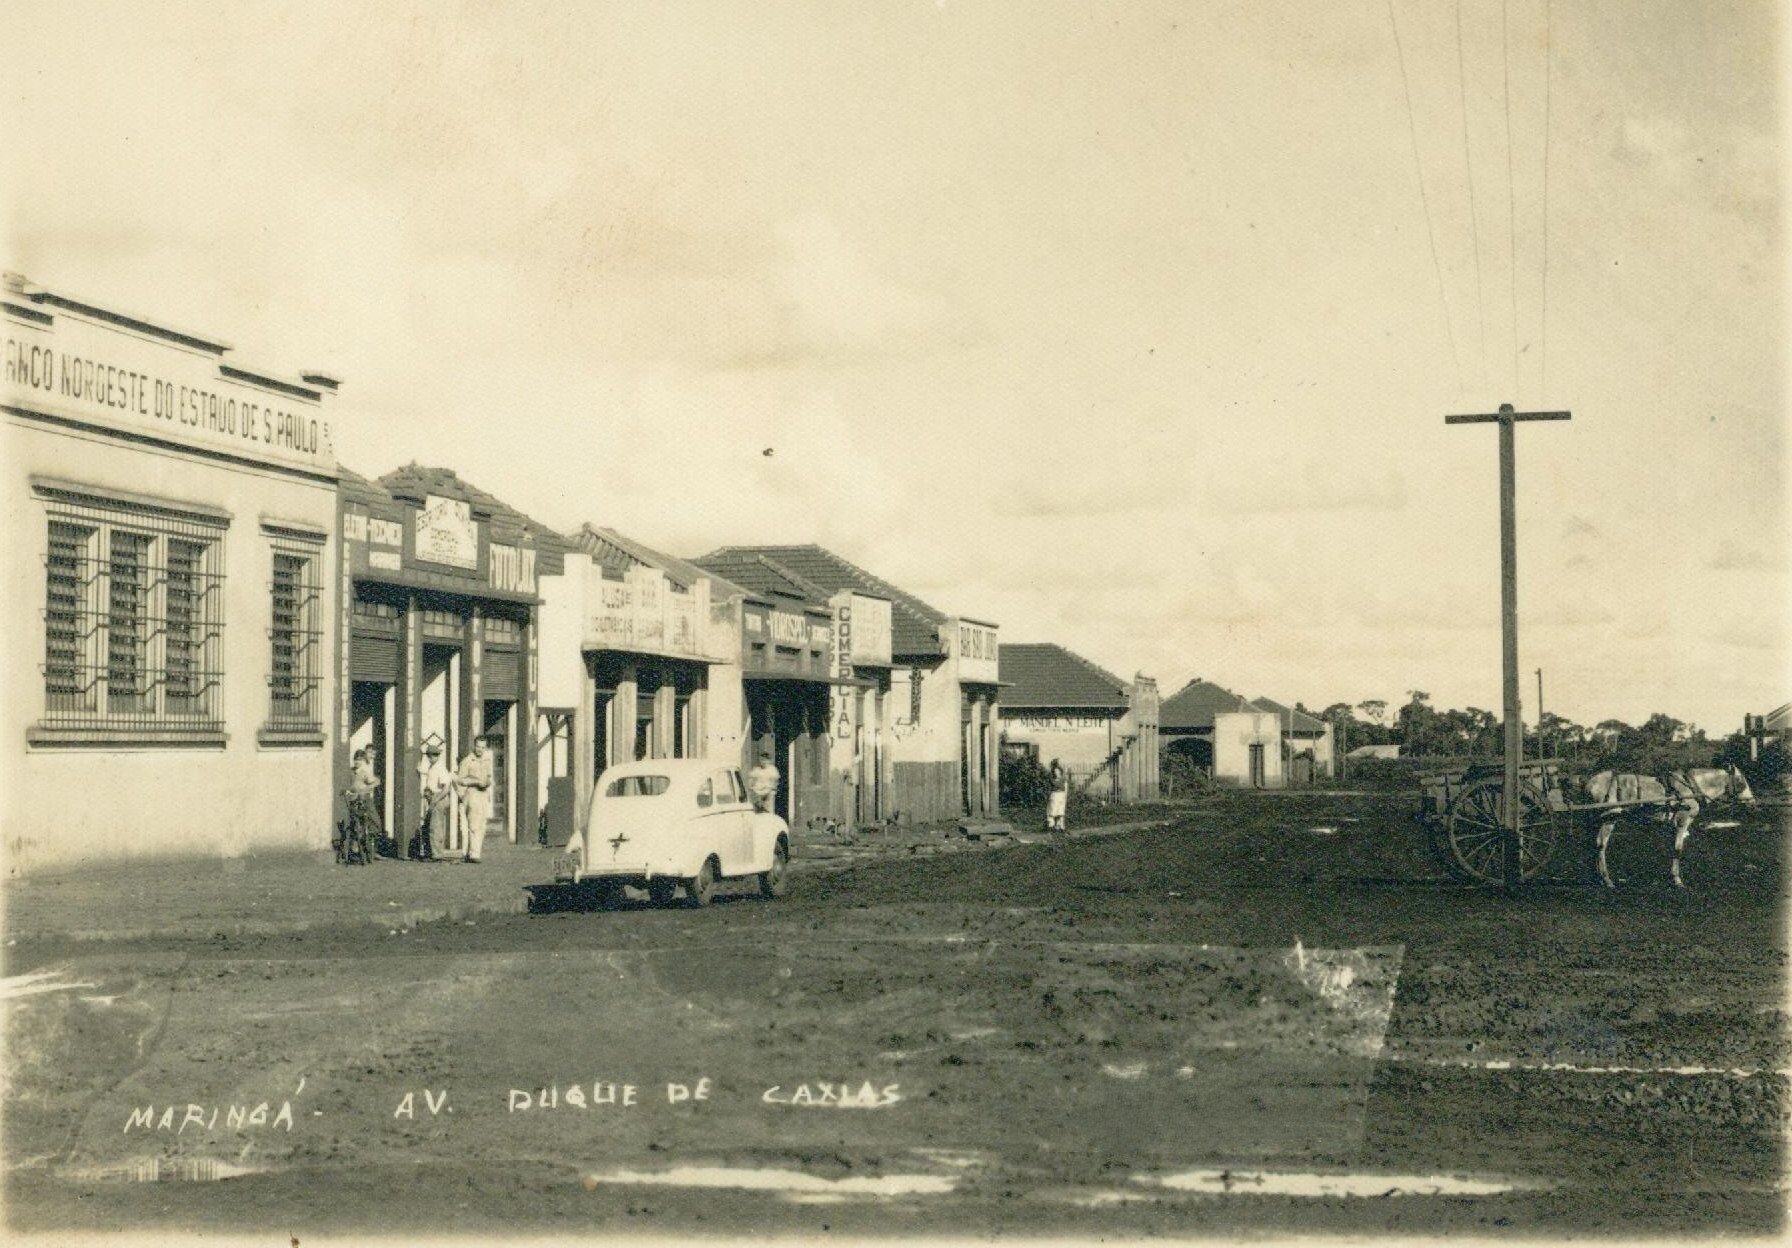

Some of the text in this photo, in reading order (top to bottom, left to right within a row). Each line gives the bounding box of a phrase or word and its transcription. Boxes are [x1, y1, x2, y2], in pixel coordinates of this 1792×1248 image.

[6, 339, 53, 390] ANCO
[61, 353, 148, 415] NOROESTE
[155, 378, 173, 420] DO
[180, 385, 236, 435] ESTADO
[242, 402, 258, 441] DE
[277, 410, 317, 454] PAULO
[489, 543, 537, 594] FOTO LUX
